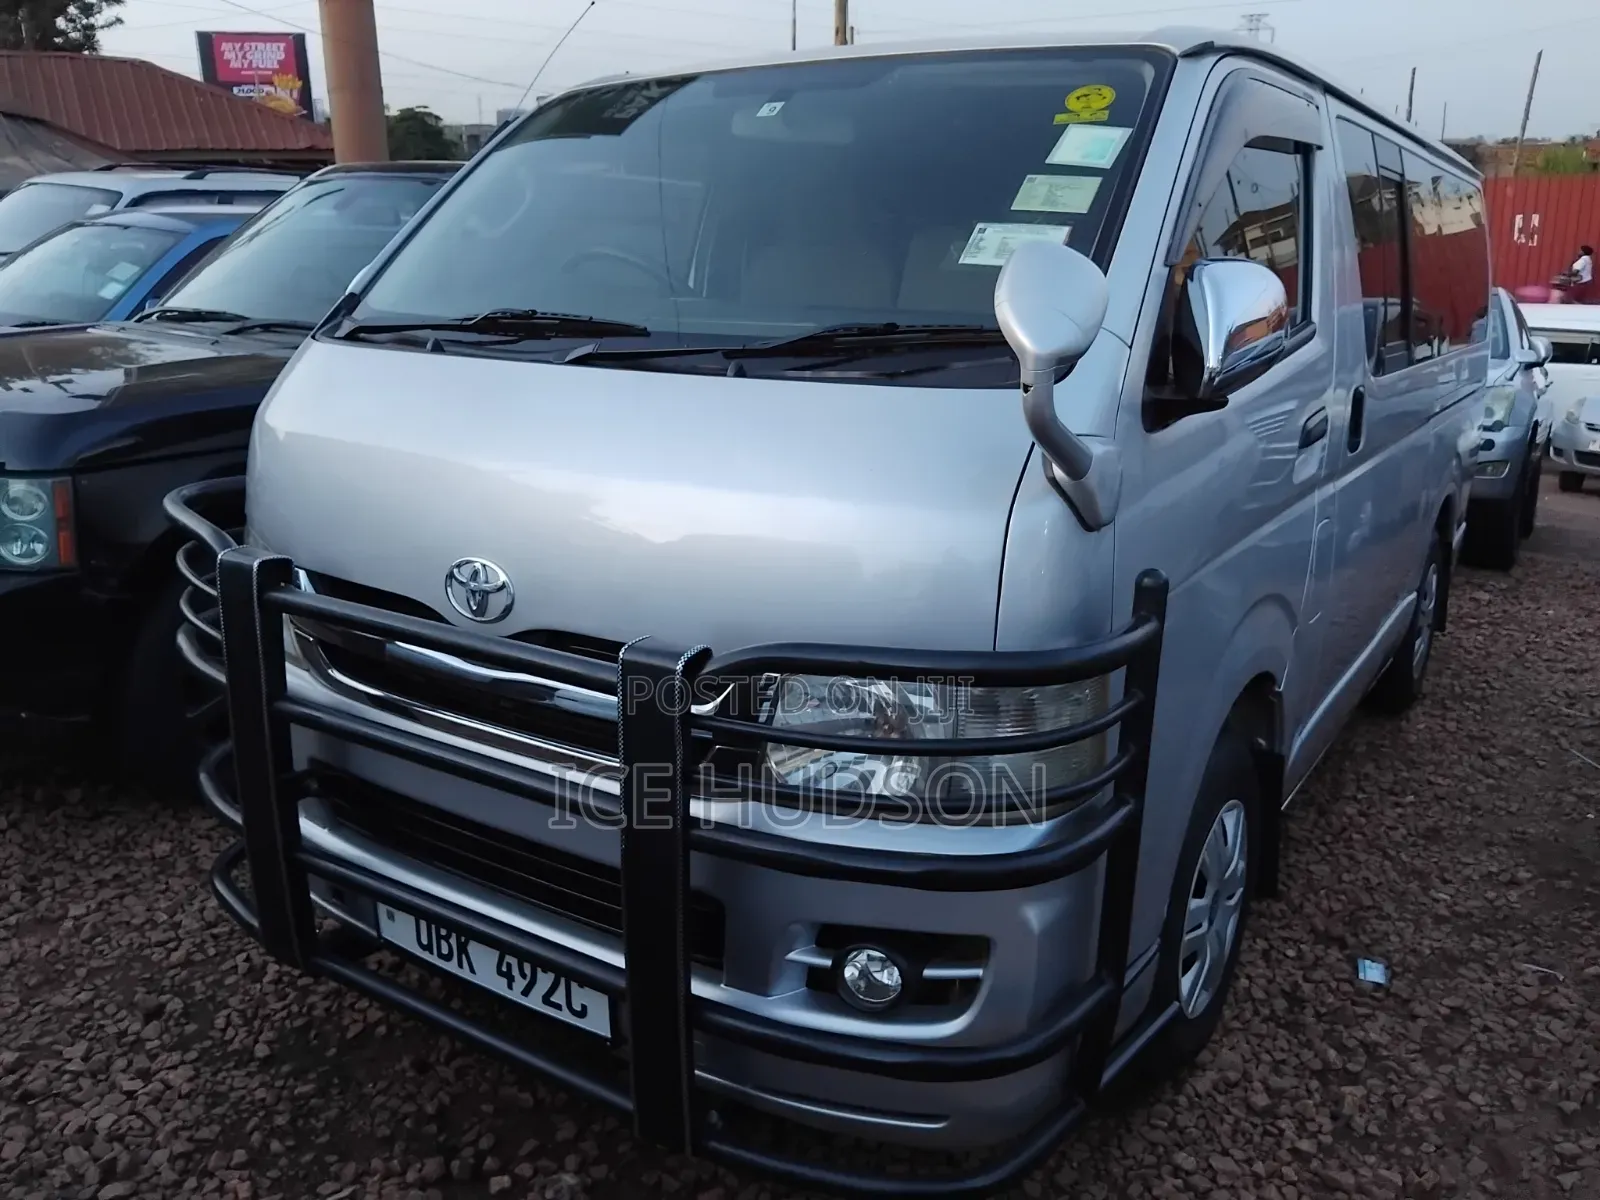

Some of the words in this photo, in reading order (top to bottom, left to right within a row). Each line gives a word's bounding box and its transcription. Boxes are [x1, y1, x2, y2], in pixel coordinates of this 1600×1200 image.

[220, 42, 242, 51] MY
[243, 42, 286, 51] STREET
[223, 51, 245, 60] MY
[245, 51, 285, 60] GRIND
[229, 60, 250, 69] MY
[251, 60, 280, 69] FUEL
[414, 917, 477, 976] UBK
[495, 950, 588, 1019] 492C
